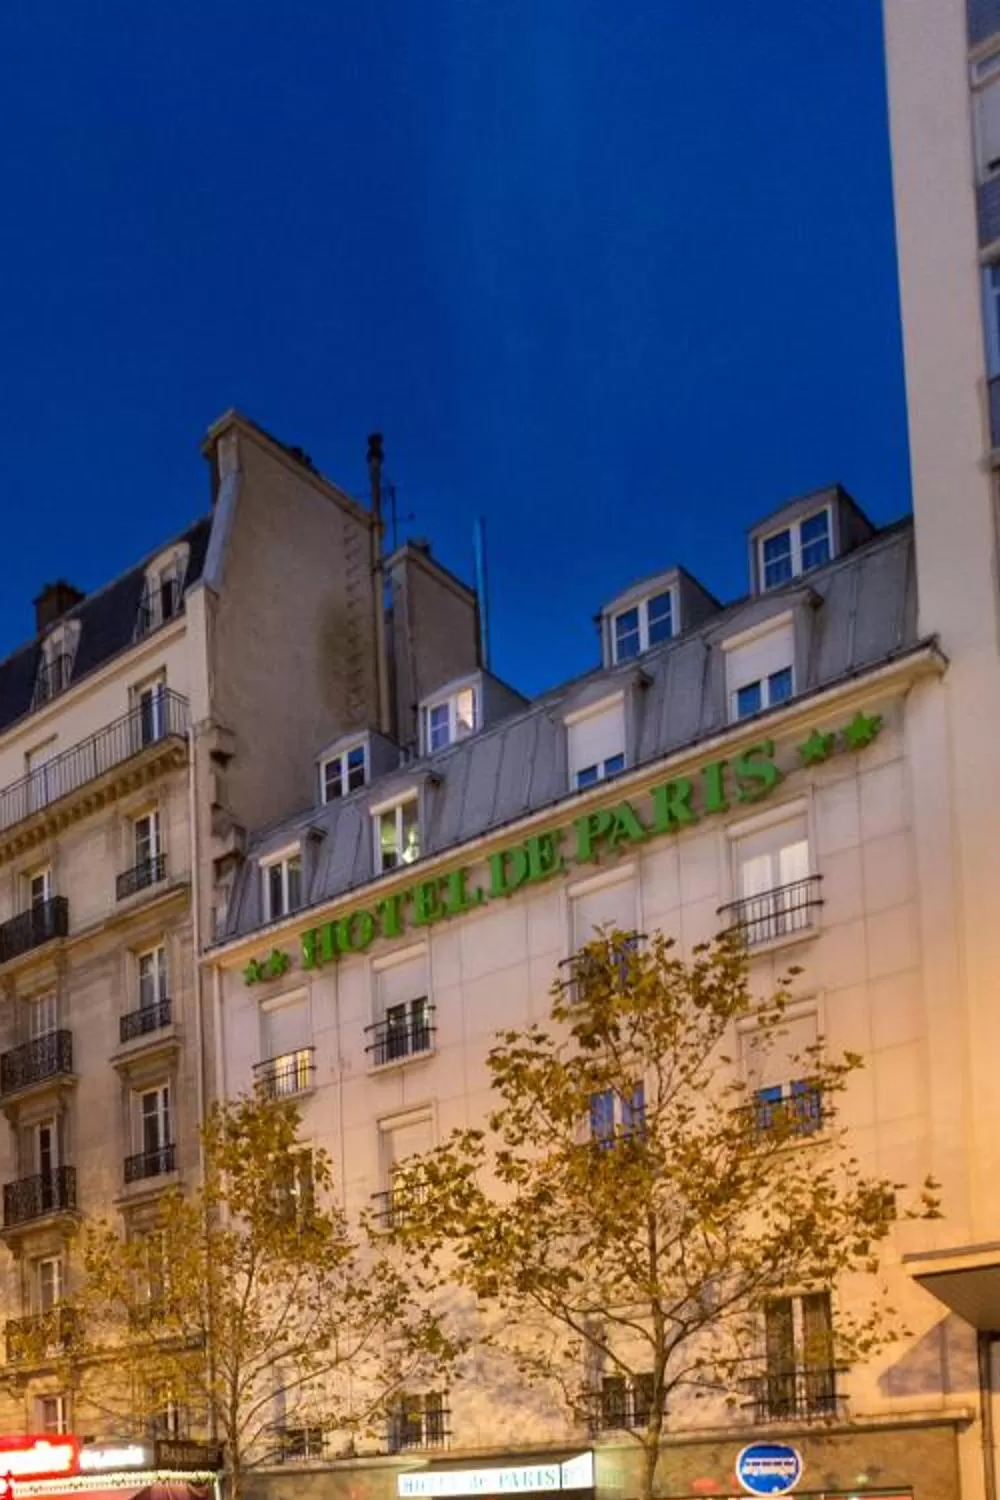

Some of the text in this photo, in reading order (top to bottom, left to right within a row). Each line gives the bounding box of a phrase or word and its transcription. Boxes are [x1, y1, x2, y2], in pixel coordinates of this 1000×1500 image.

[489, 832, 565, 898] DE
[574, 739, 780, 864] PARIS
[500, 1469, 556, 1488] PARIS
